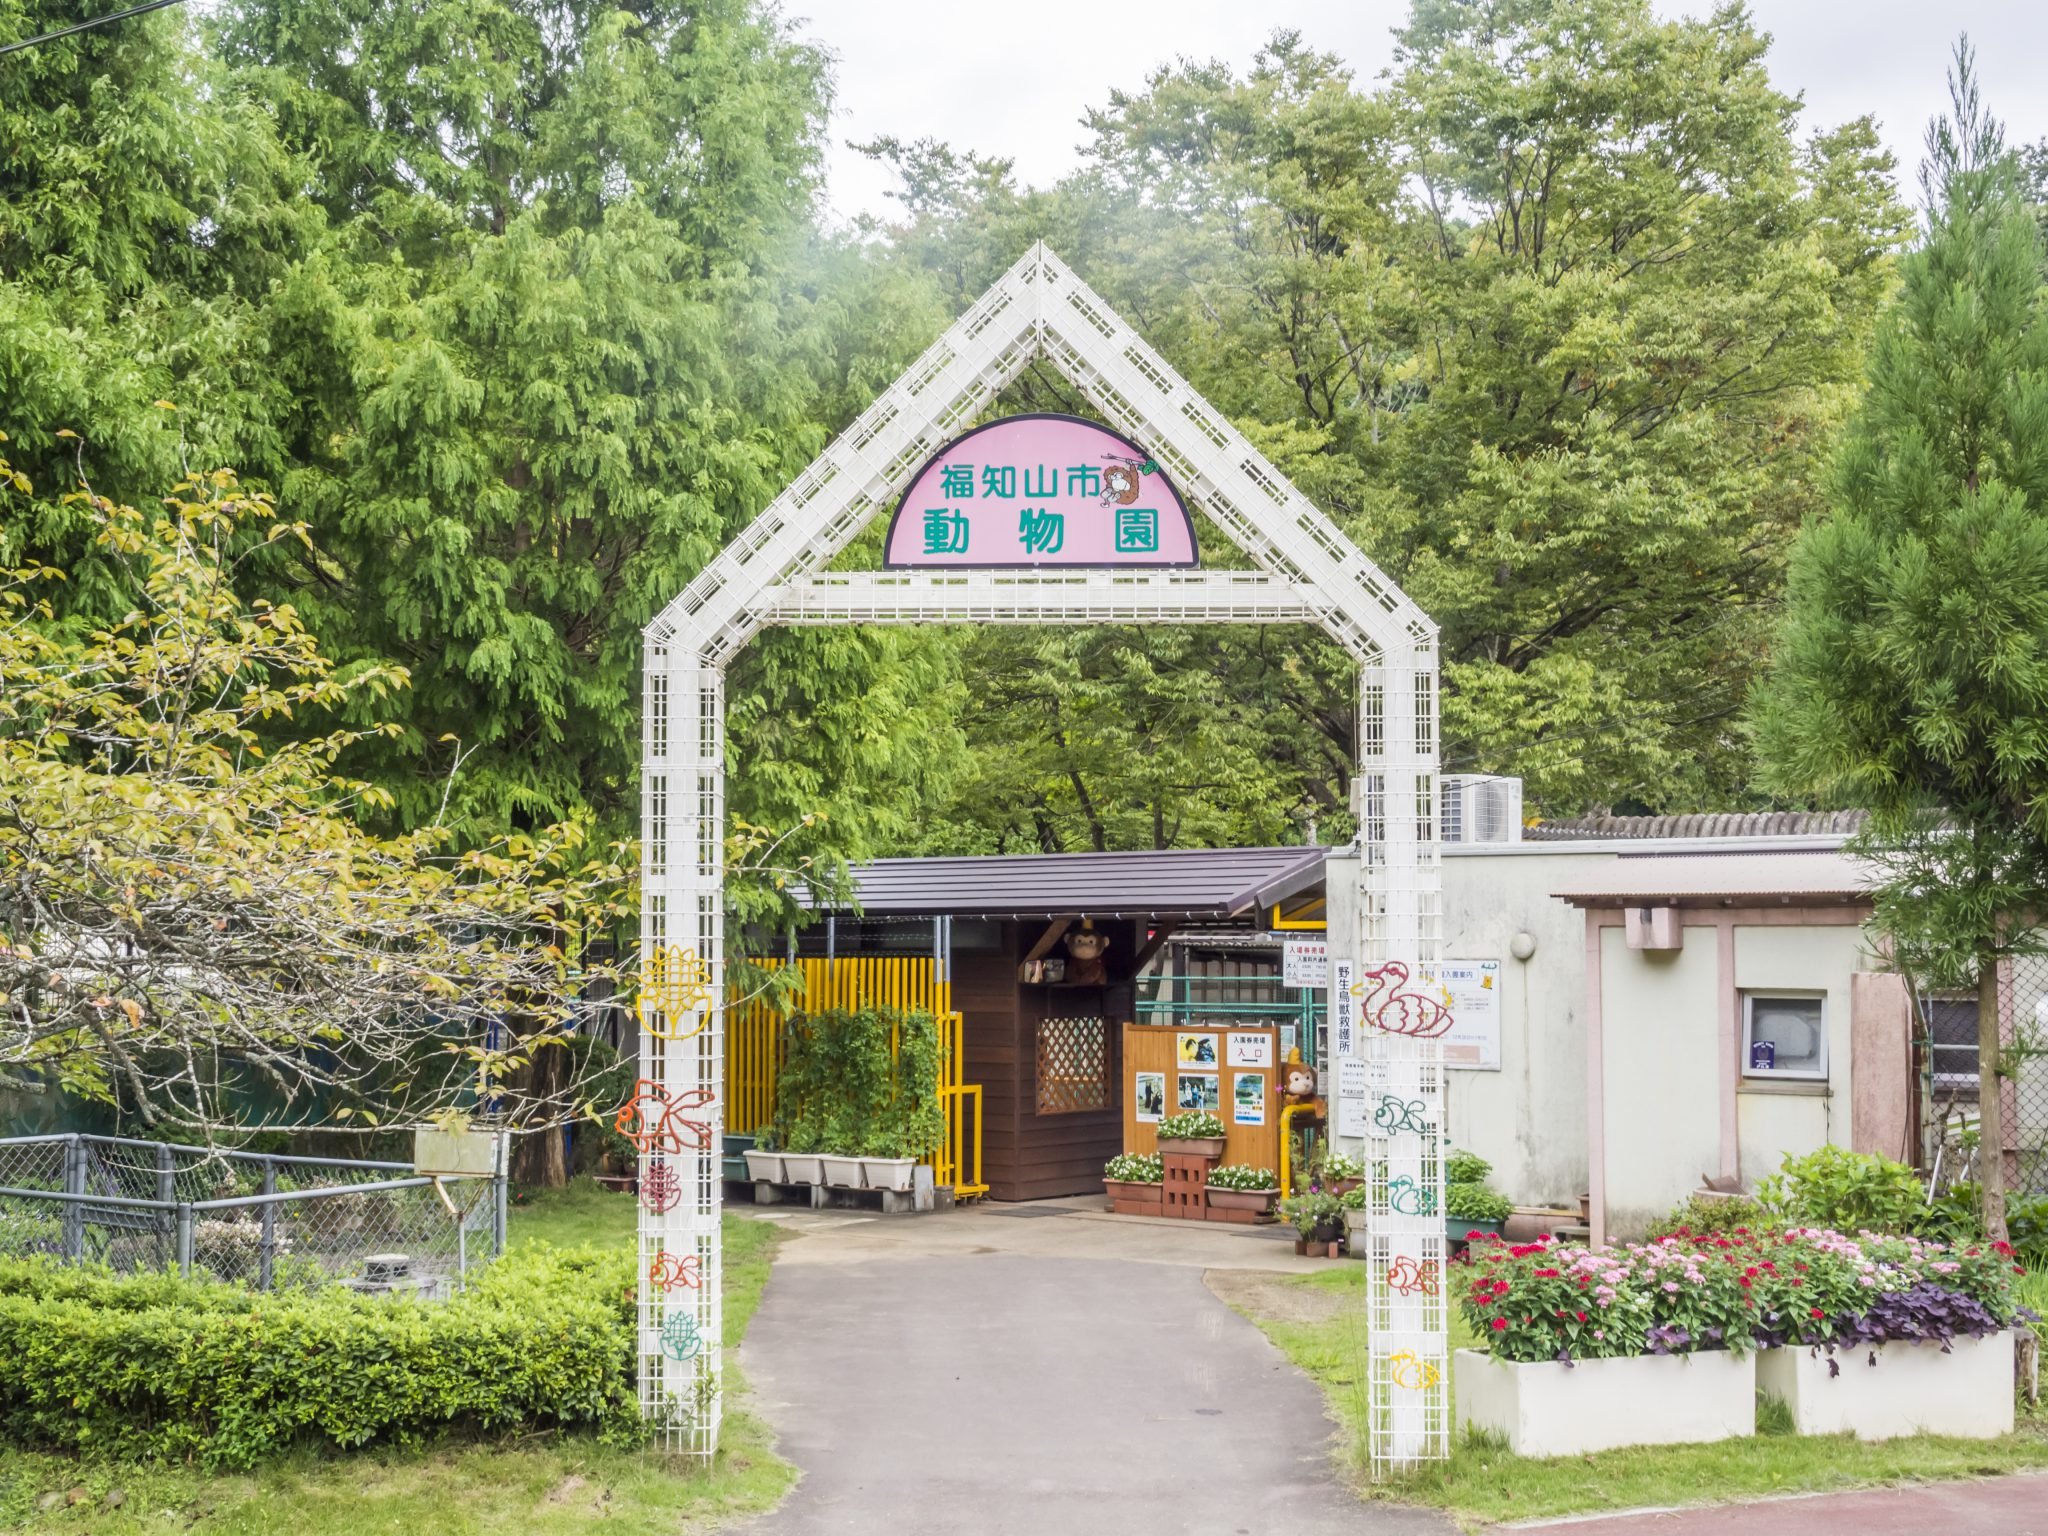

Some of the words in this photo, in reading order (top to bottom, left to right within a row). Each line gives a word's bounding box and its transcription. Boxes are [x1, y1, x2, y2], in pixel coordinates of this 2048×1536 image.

[939, 463, 1102, 499] 福知山市
[922, 507, 1159, 554] 動物園
[1338, 966, 1350, 1053] 野生鳥獣救護所
[1238, 1047, 1262, 1058] 入口
